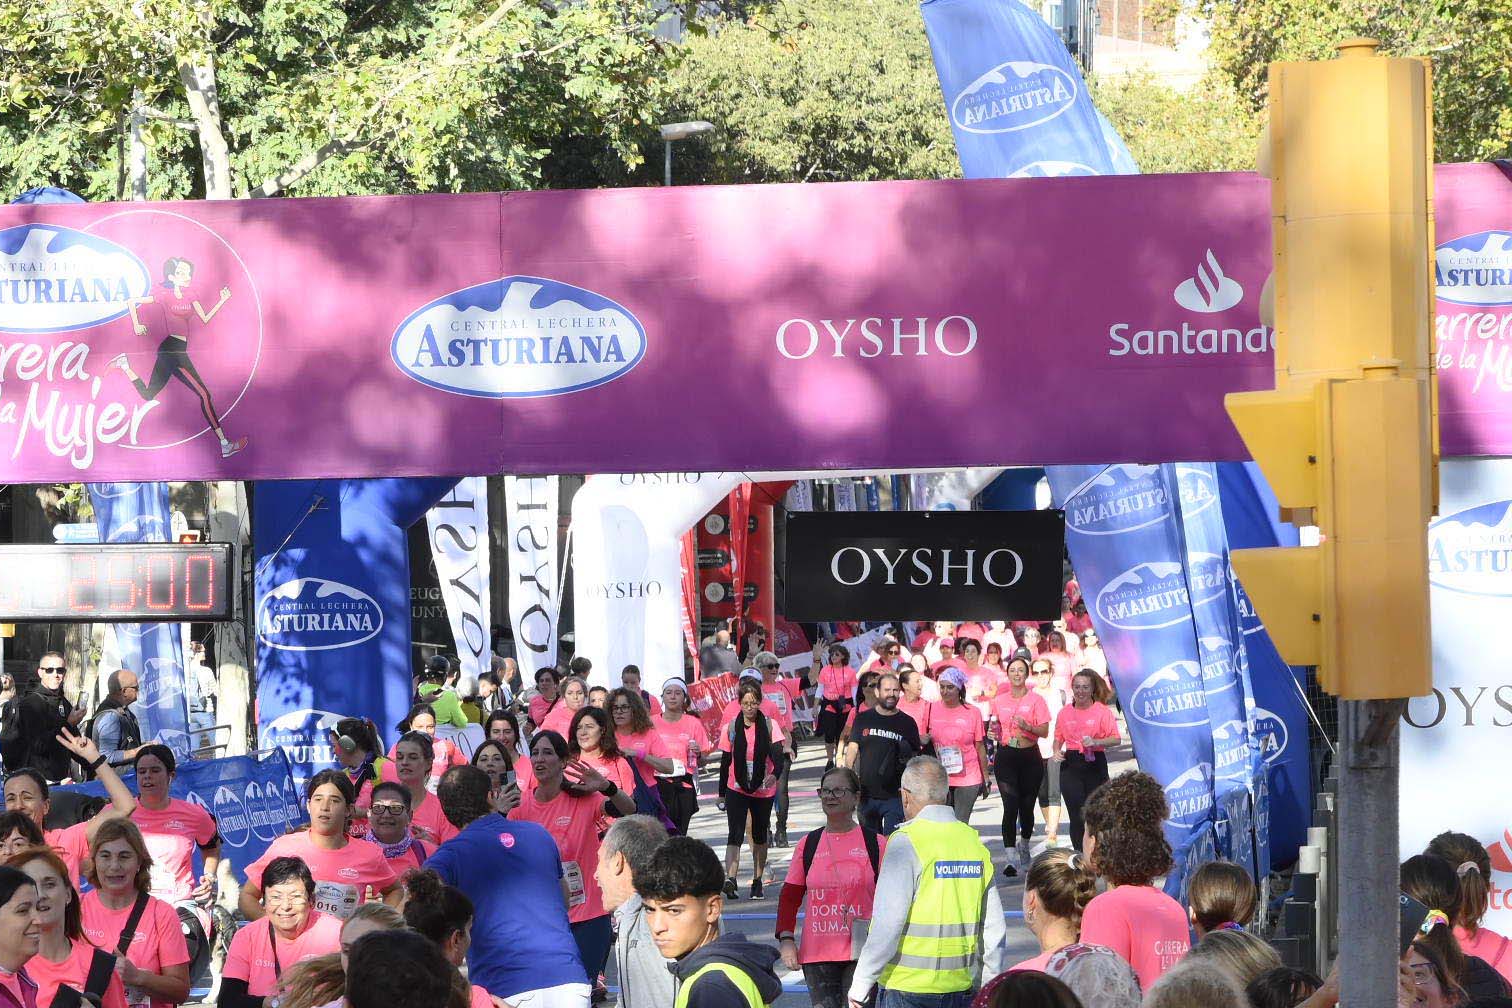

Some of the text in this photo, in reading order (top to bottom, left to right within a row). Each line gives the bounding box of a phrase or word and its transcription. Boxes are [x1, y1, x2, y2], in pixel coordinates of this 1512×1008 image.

[450, 317, 617, 332] CENTRAL LECHERA
[412, 323, 627, 367] ASTURIANA
[775, 315, 978, 360] OYSHO
[10, 376, 161, 470] Mujer
[829, 547, 1024, 588] OYSHO
[586, 581, 662, 600] OYSHO
[274, 602, 369, 611] CENTRAL LECHERA
[262, 607, 374, 634] ASTURIANA
[869, 728, 903, 742] ELEMENT
[810, 889, 825, 900] TU
[812, 904, 863, 917] DORSAL
[812, 920, 850, 933] SUMA
